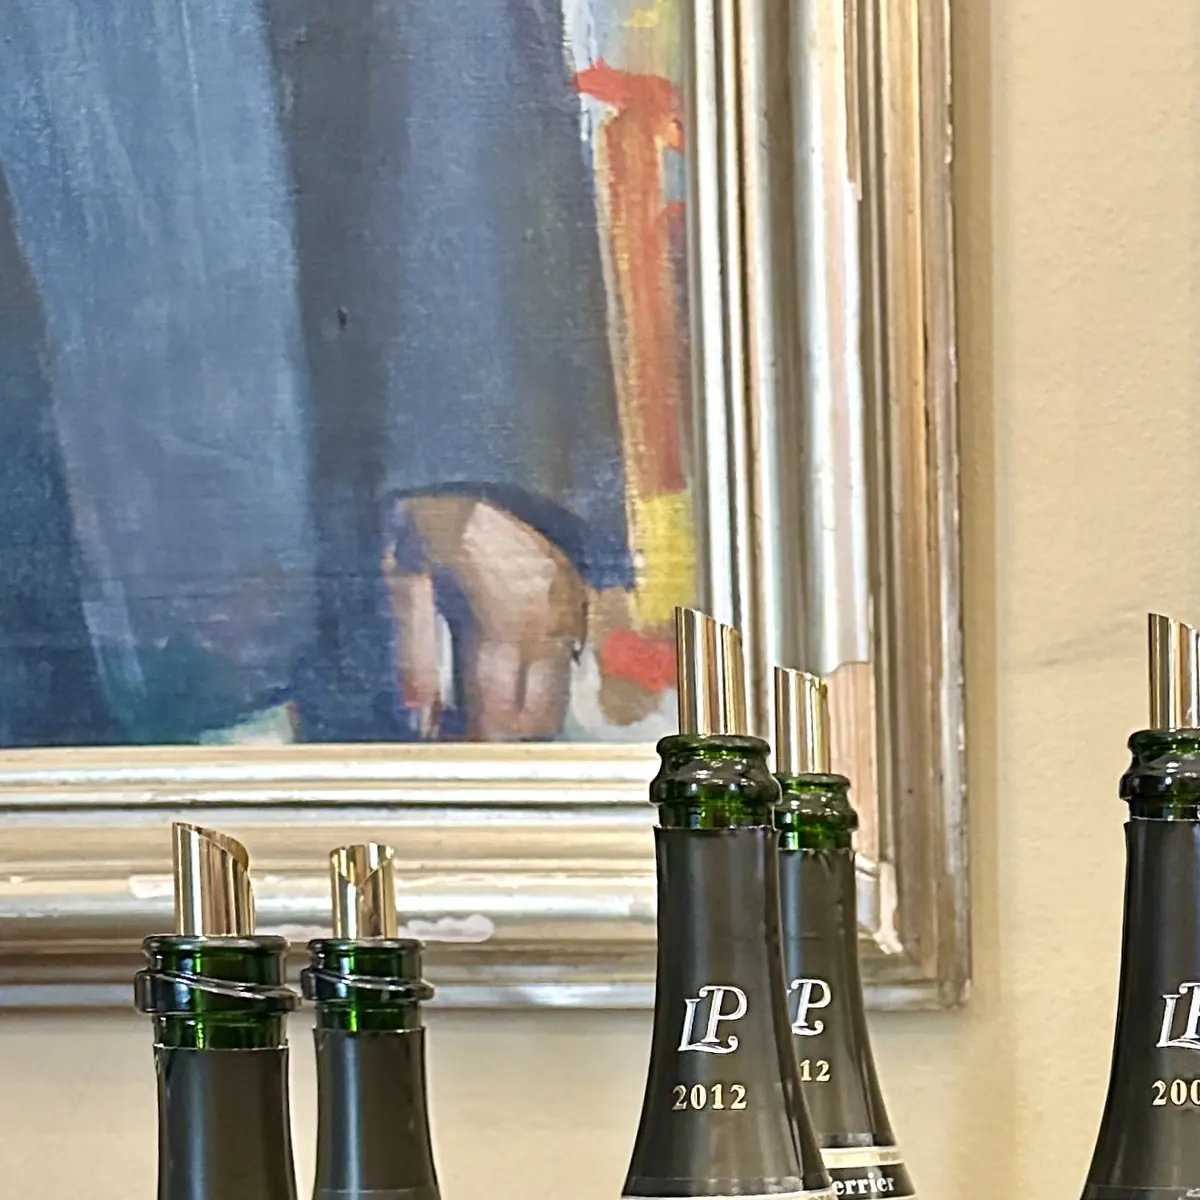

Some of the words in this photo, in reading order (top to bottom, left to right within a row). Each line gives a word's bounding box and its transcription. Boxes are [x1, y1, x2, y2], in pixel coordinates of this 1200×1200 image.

[677, 984, 749, 1055] LP
[786, 978, 832, 1036] P
[799, 1058, 831, 1083] 12
[671, 1083, 748, 1111] 2012
